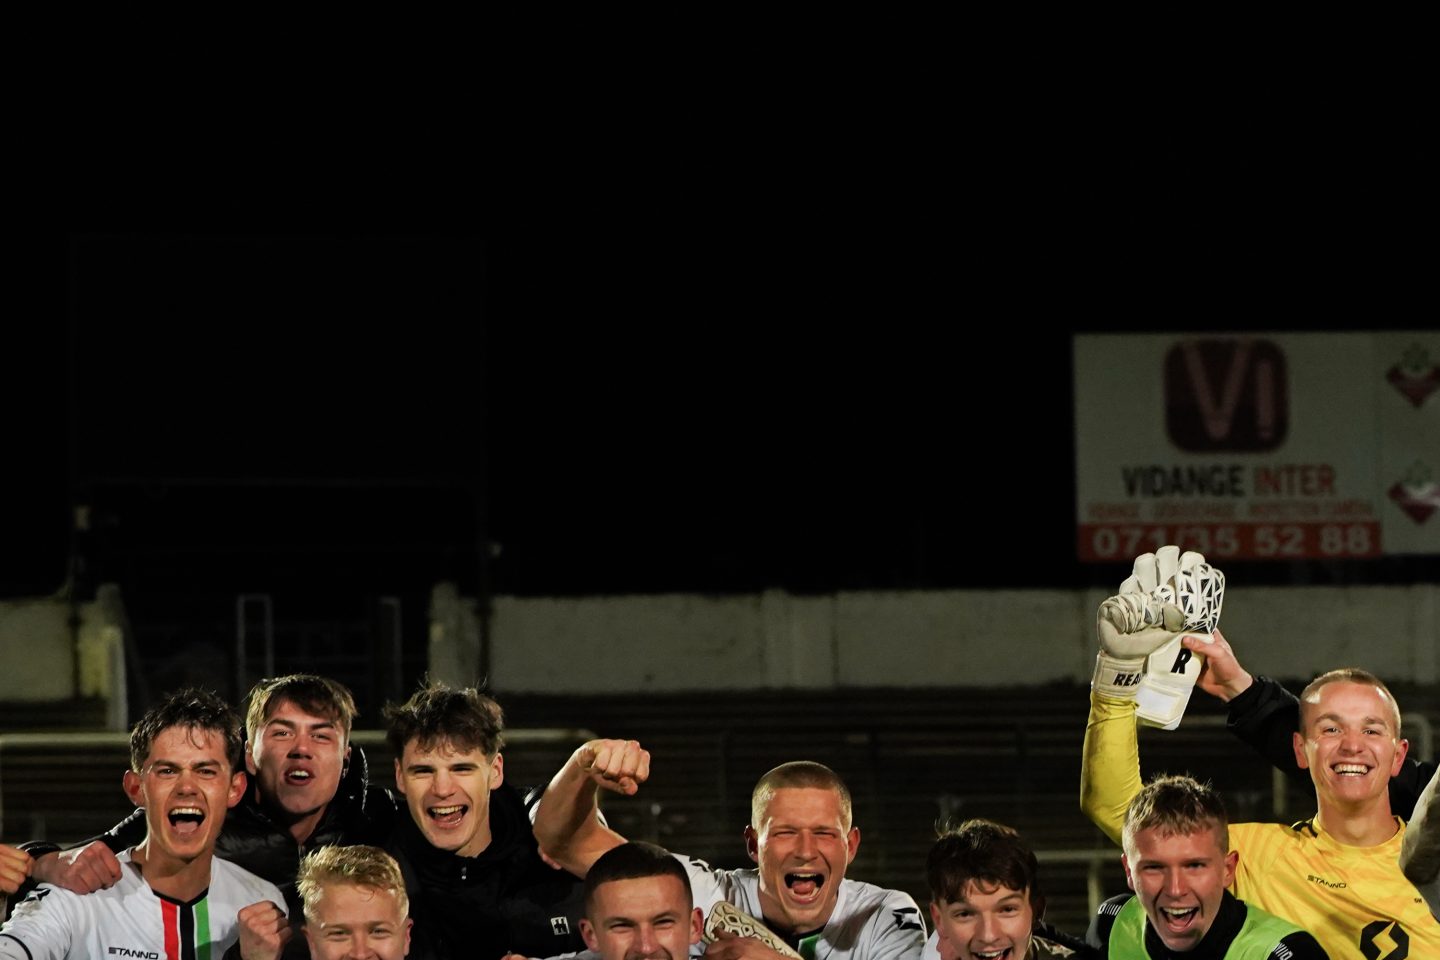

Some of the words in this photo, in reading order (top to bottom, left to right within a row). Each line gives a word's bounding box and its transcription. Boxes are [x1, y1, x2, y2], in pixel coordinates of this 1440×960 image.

[1121, 465, 1244, 497] VIDANGE
[1253, 463, 1335, 496] INTER
[1253, 526, 1305, 555] 52
[1319, 524, 1371, 556] 88
[1170, 647, 1192, 675] R
[1306, 874, 1348, 889] STANNO
[108, 946, 159, 960] STANNO
